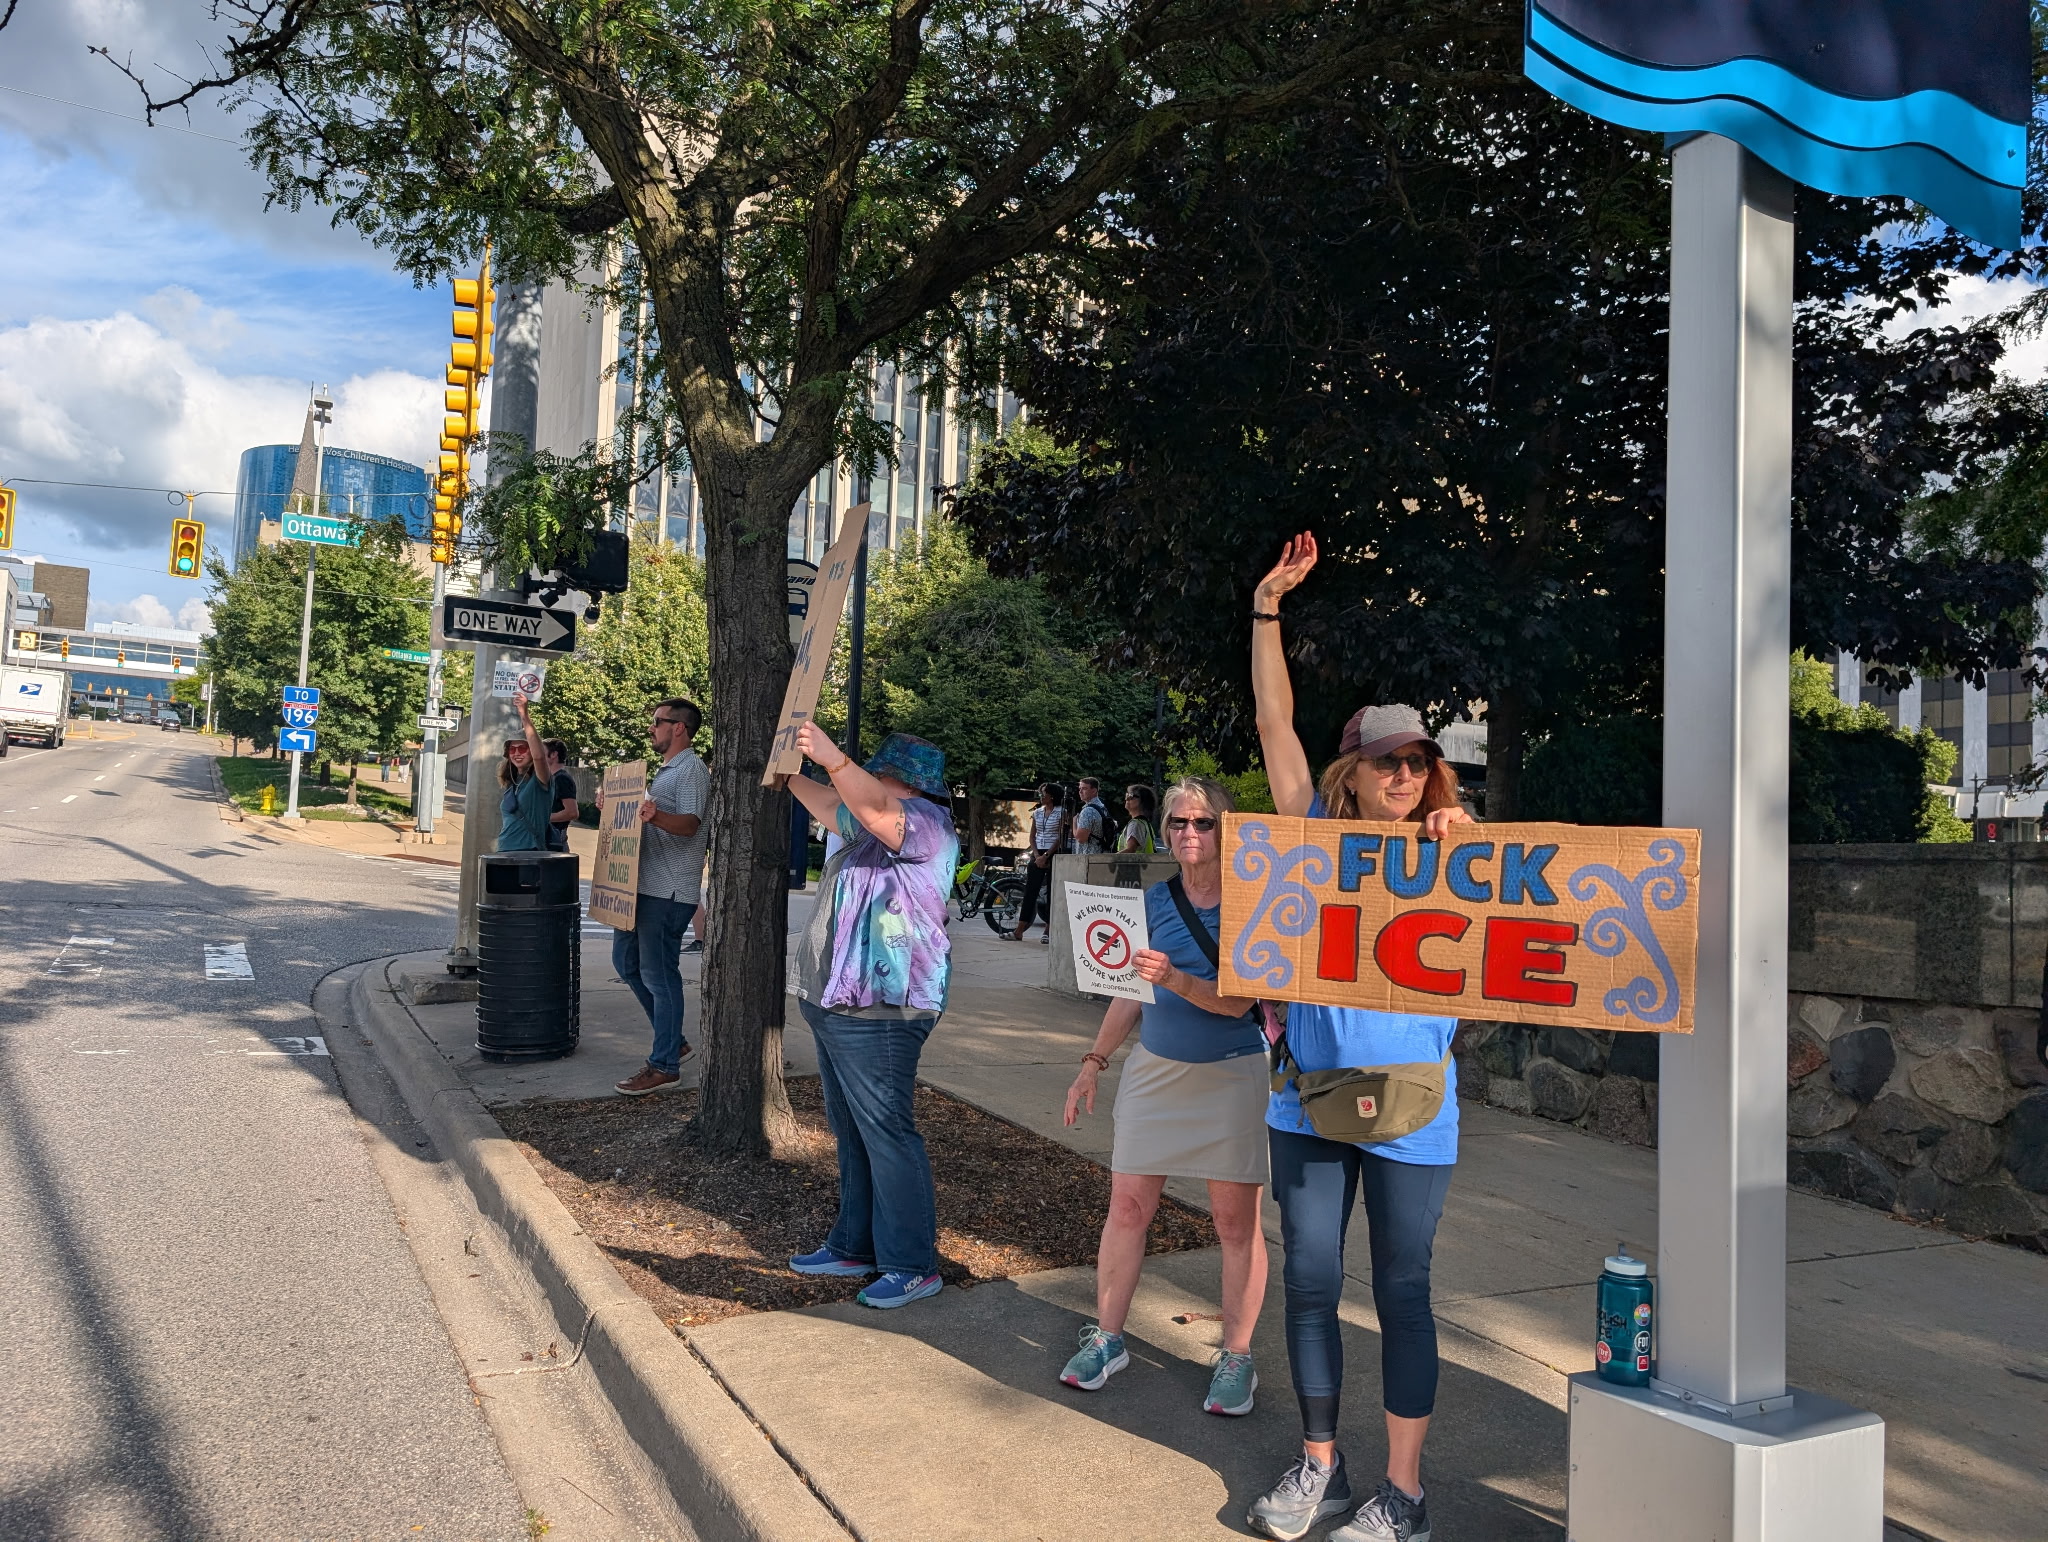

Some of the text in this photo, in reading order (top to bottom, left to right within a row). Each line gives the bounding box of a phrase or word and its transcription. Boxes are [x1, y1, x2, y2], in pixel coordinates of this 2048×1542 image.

[343, 450, 386, 465] Children's
[386, 459, 417, 474] Hospital
[458, 610, 543, 636] ONE WAY
[391, 650, 413, 660] Ottawa
[294, 690, 309, 700] TO
[287, 708, 315, 724] 196
[614, 800, 639, 831] ADOPT
[608, 862, 629, 884] POLICIES
[1338, 832, 1560, 907] FUCK
[600, 891, 614, 911] KENT
[613, 895, 634, 918] COUNTY
[1082, 890, 1096, 898] Rapids
[1075, 904, 1138, 929] WE KNOW THAT
[1079, 954, 1106, 980] YOU'RE
[1316, 903, 1580, 1007] ICE
[903, 1275, 923, 1293] HOKA
[1638, 1337, 1649, 1347] FDT
